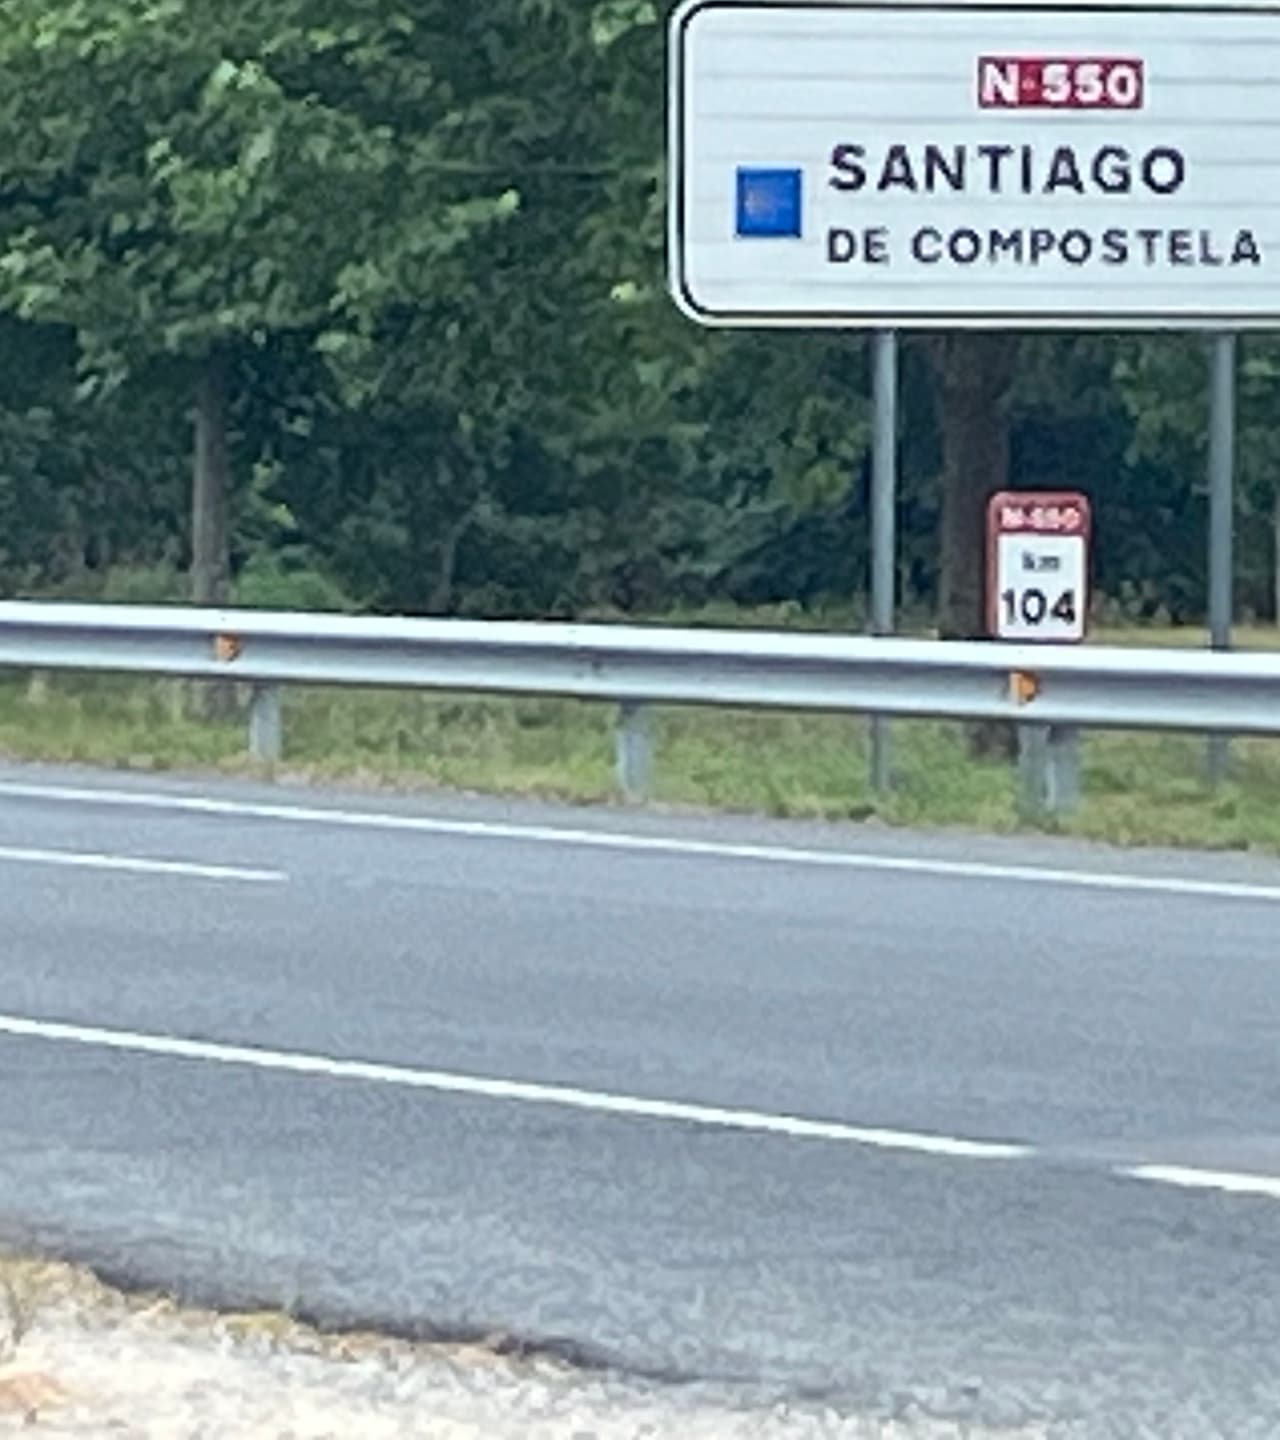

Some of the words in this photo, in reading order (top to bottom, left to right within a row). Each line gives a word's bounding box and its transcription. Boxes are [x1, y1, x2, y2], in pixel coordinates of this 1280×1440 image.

[981, 63, 1139, 104] N-550
[828, 143, 1187, 196] SANTIAGO
[826, 228, 889, 263] DE
[911, 228, 1262, 266] COMPOSTELA
[1001, 588, 1076, 626] 104
